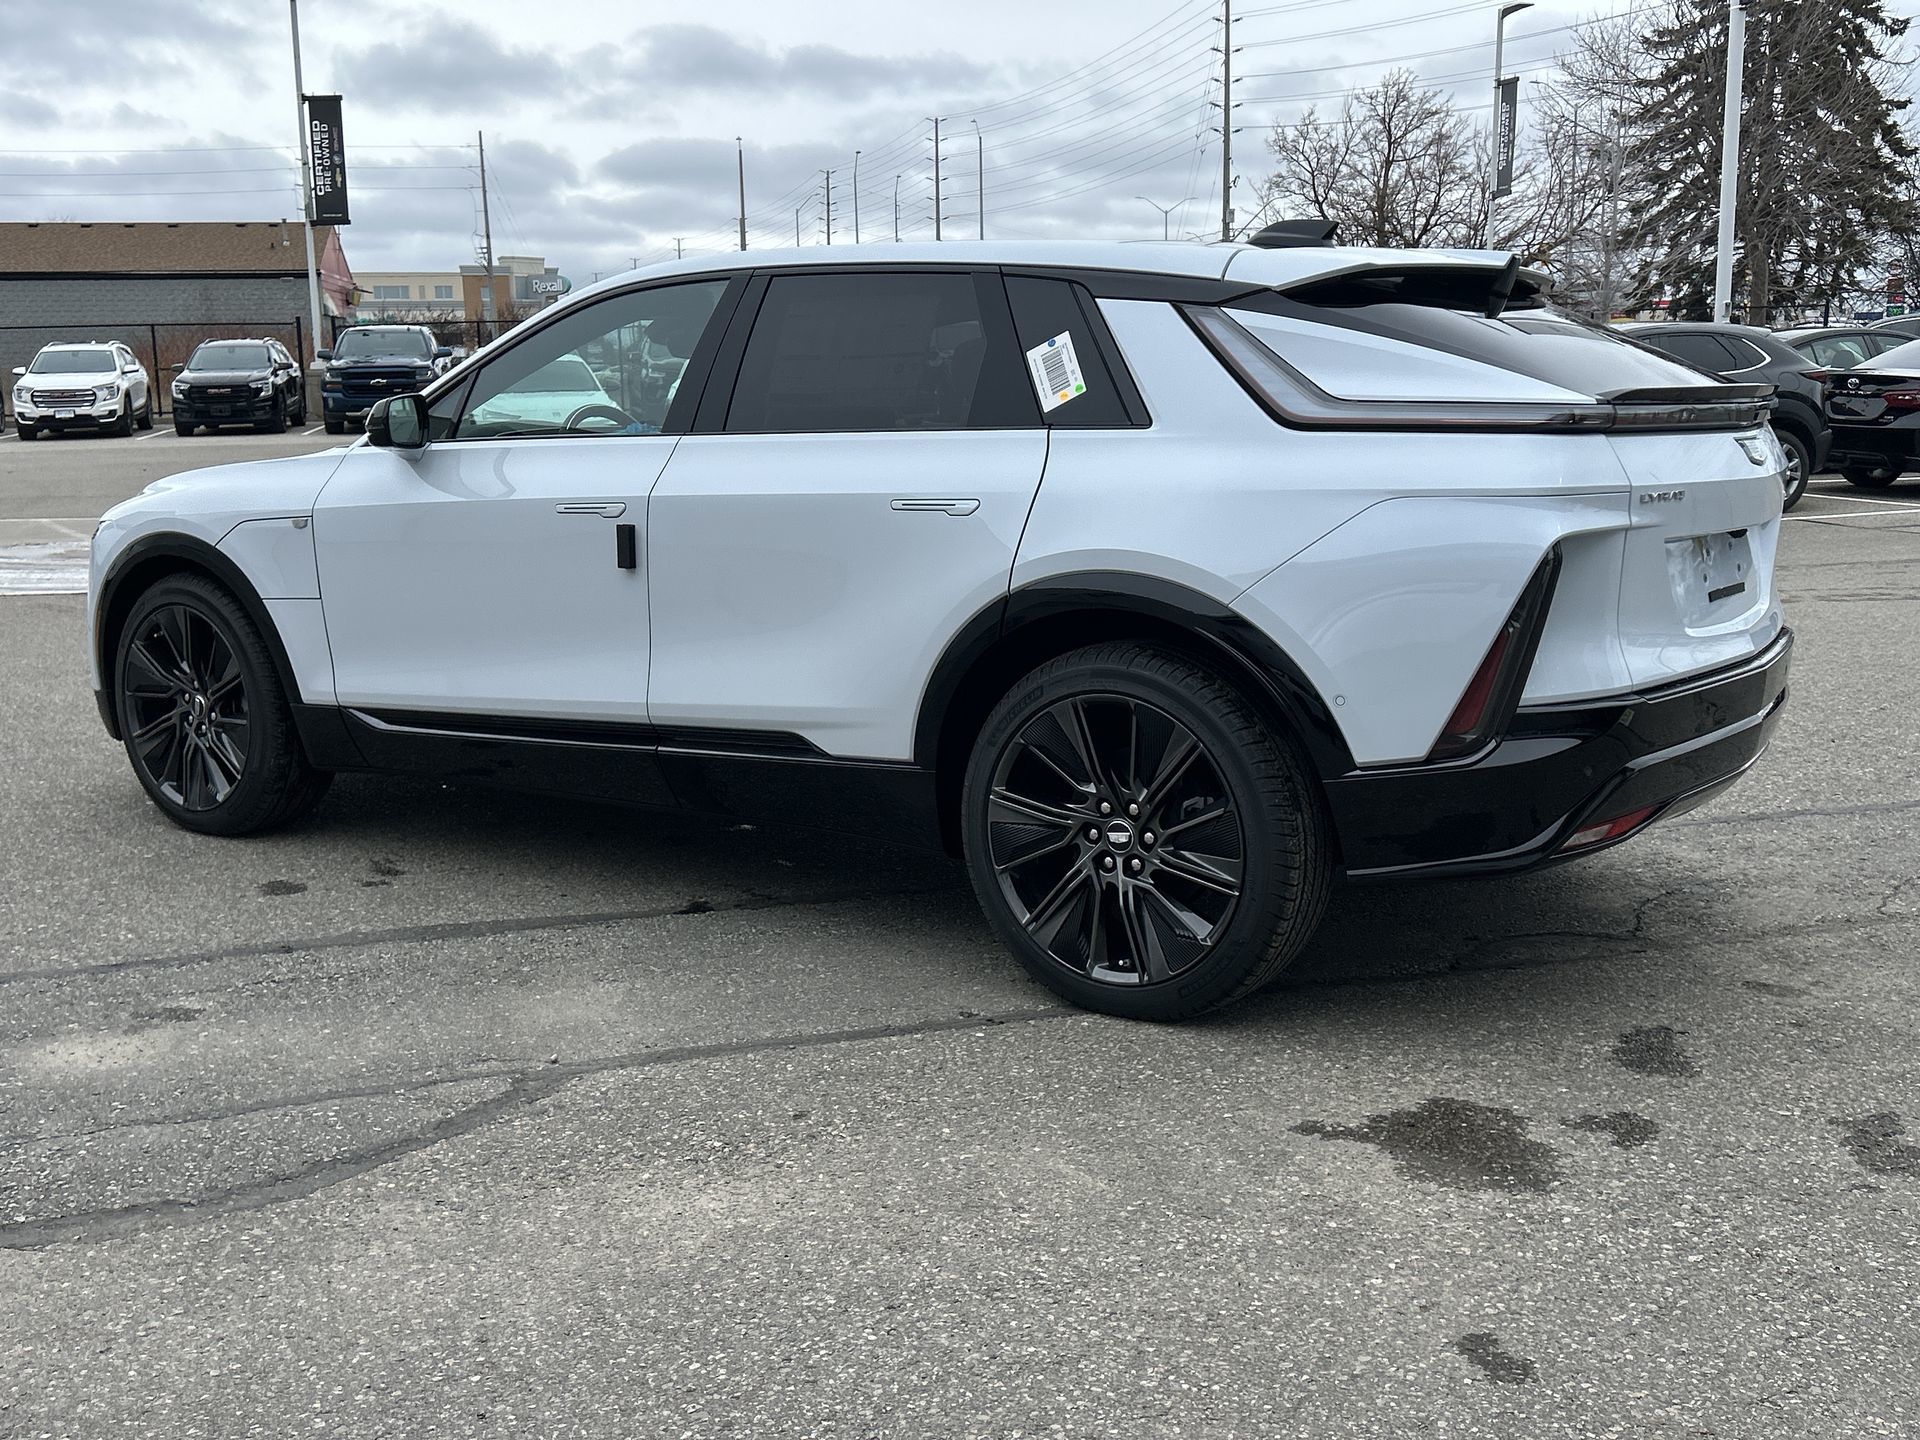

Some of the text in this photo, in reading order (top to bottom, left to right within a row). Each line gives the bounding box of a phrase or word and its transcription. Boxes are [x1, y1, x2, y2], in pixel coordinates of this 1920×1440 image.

[312, 120, 325, 196] CERTIFIED
[320, 123, 333, 192] PRE-OWNED
[532, 279, 563, 293] Rexall
